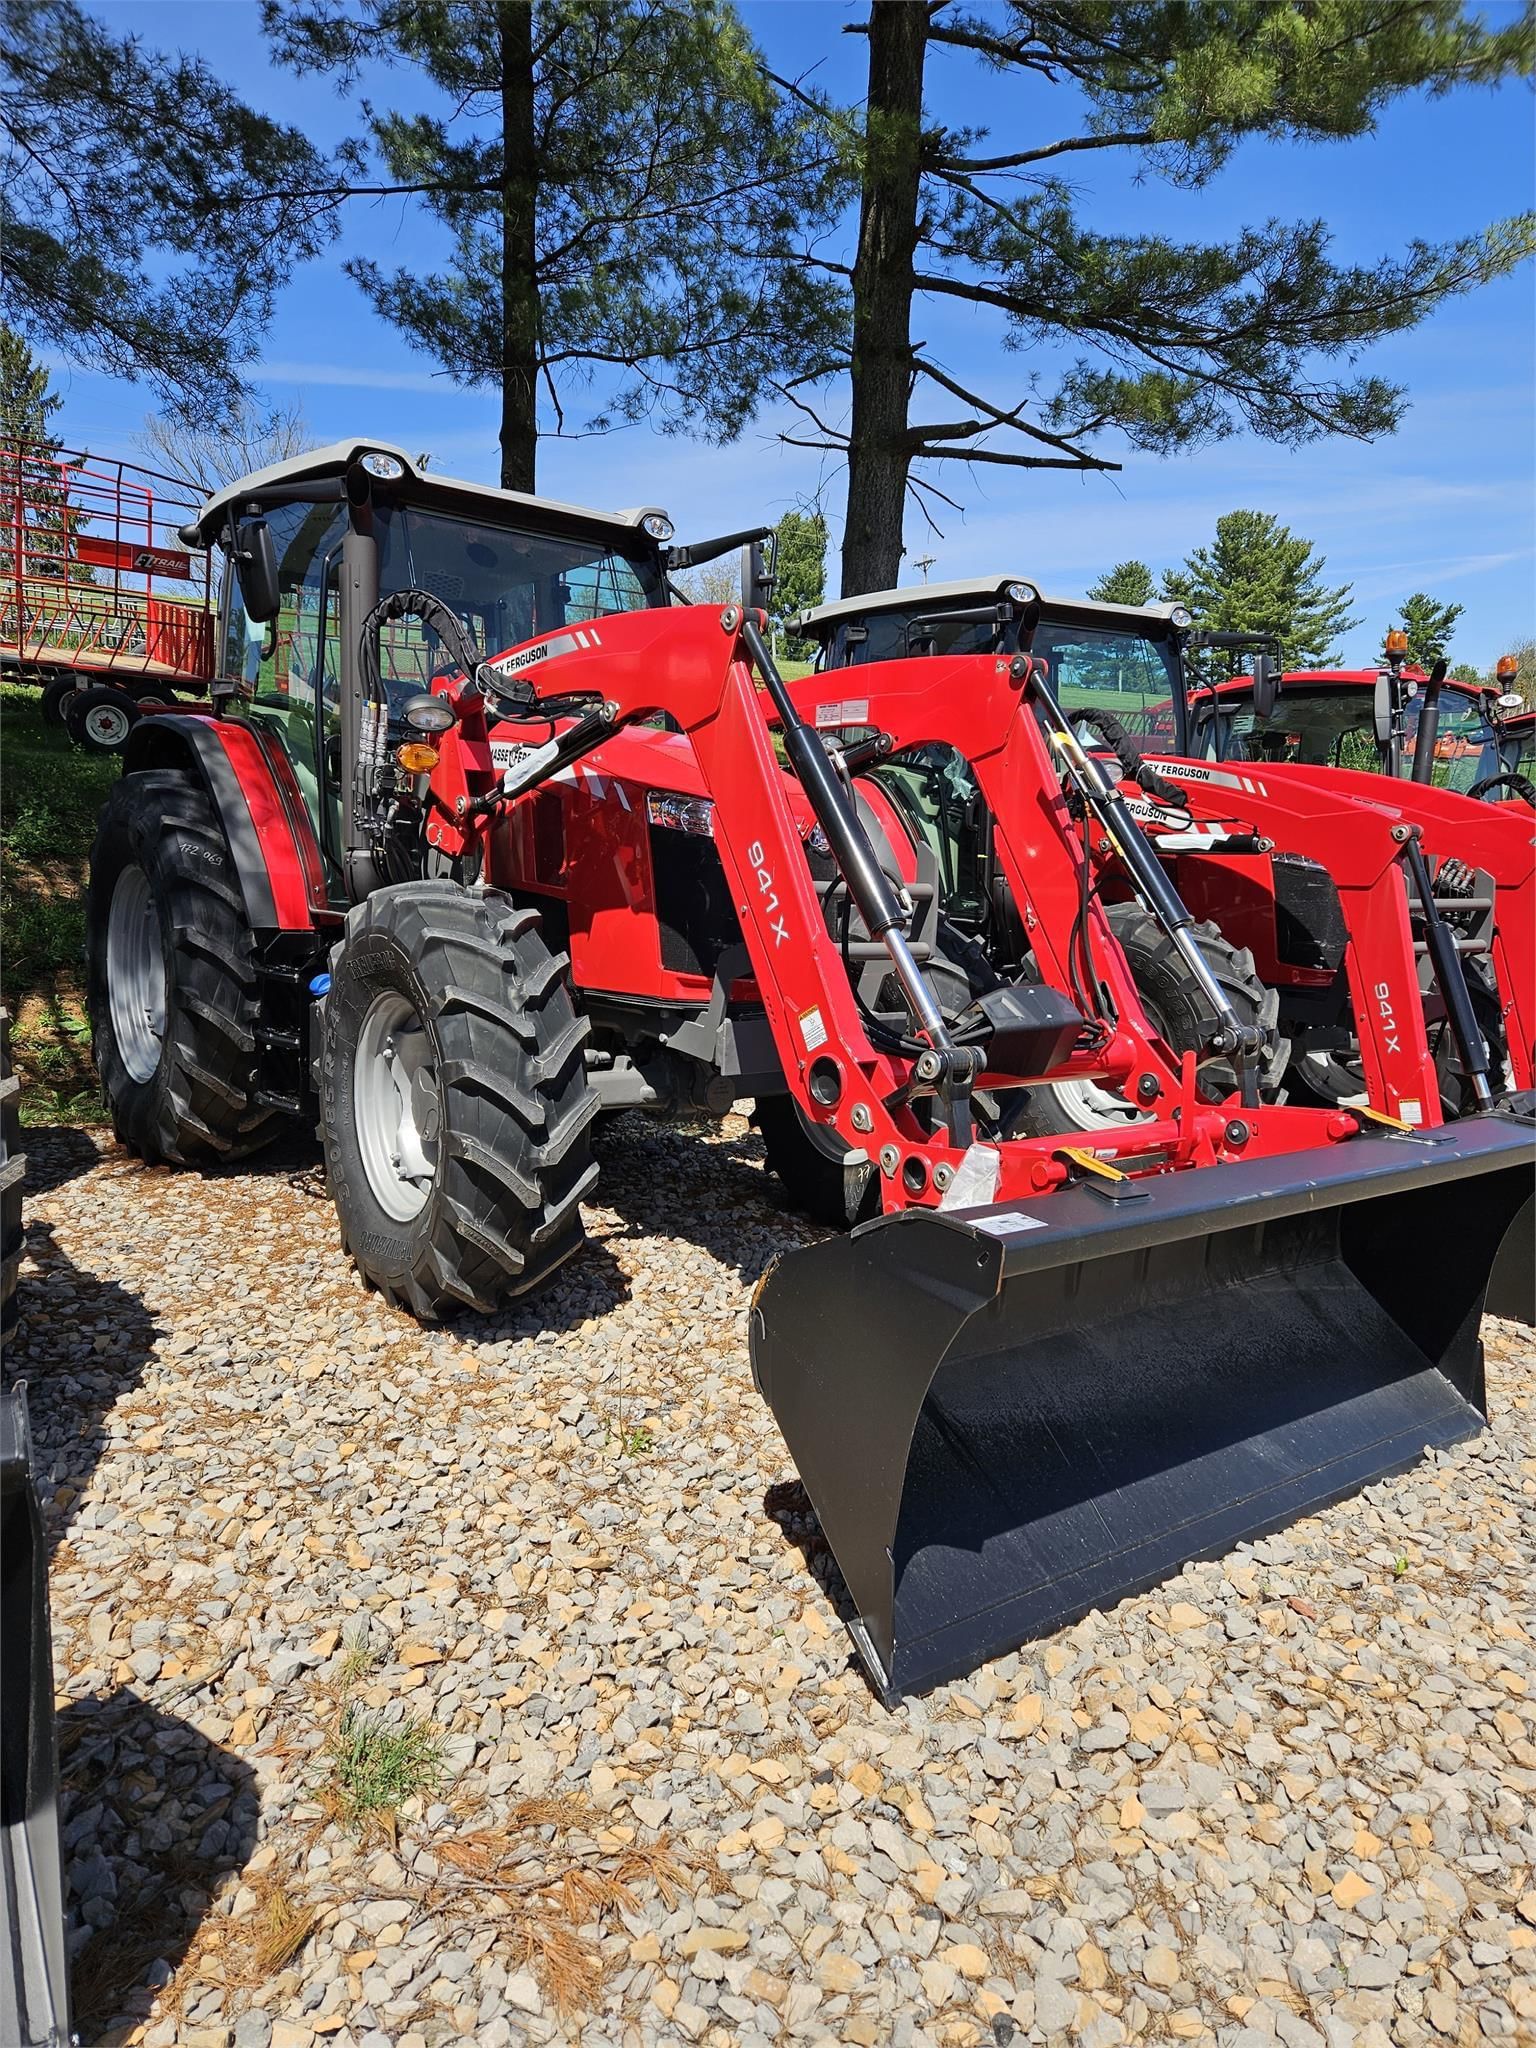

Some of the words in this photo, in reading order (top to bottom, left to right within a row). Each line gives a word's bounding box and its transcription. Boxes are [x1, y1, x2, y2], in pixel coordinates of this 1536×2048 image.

[506, 644, 548, 673] FERGUSON
[1161, 765, 1210, 781] FERGUSON
[179, 843, 199, 856] 172
[748, 841, 791, 949] 941X
[1375, 982, 1402, 1054] 941X
